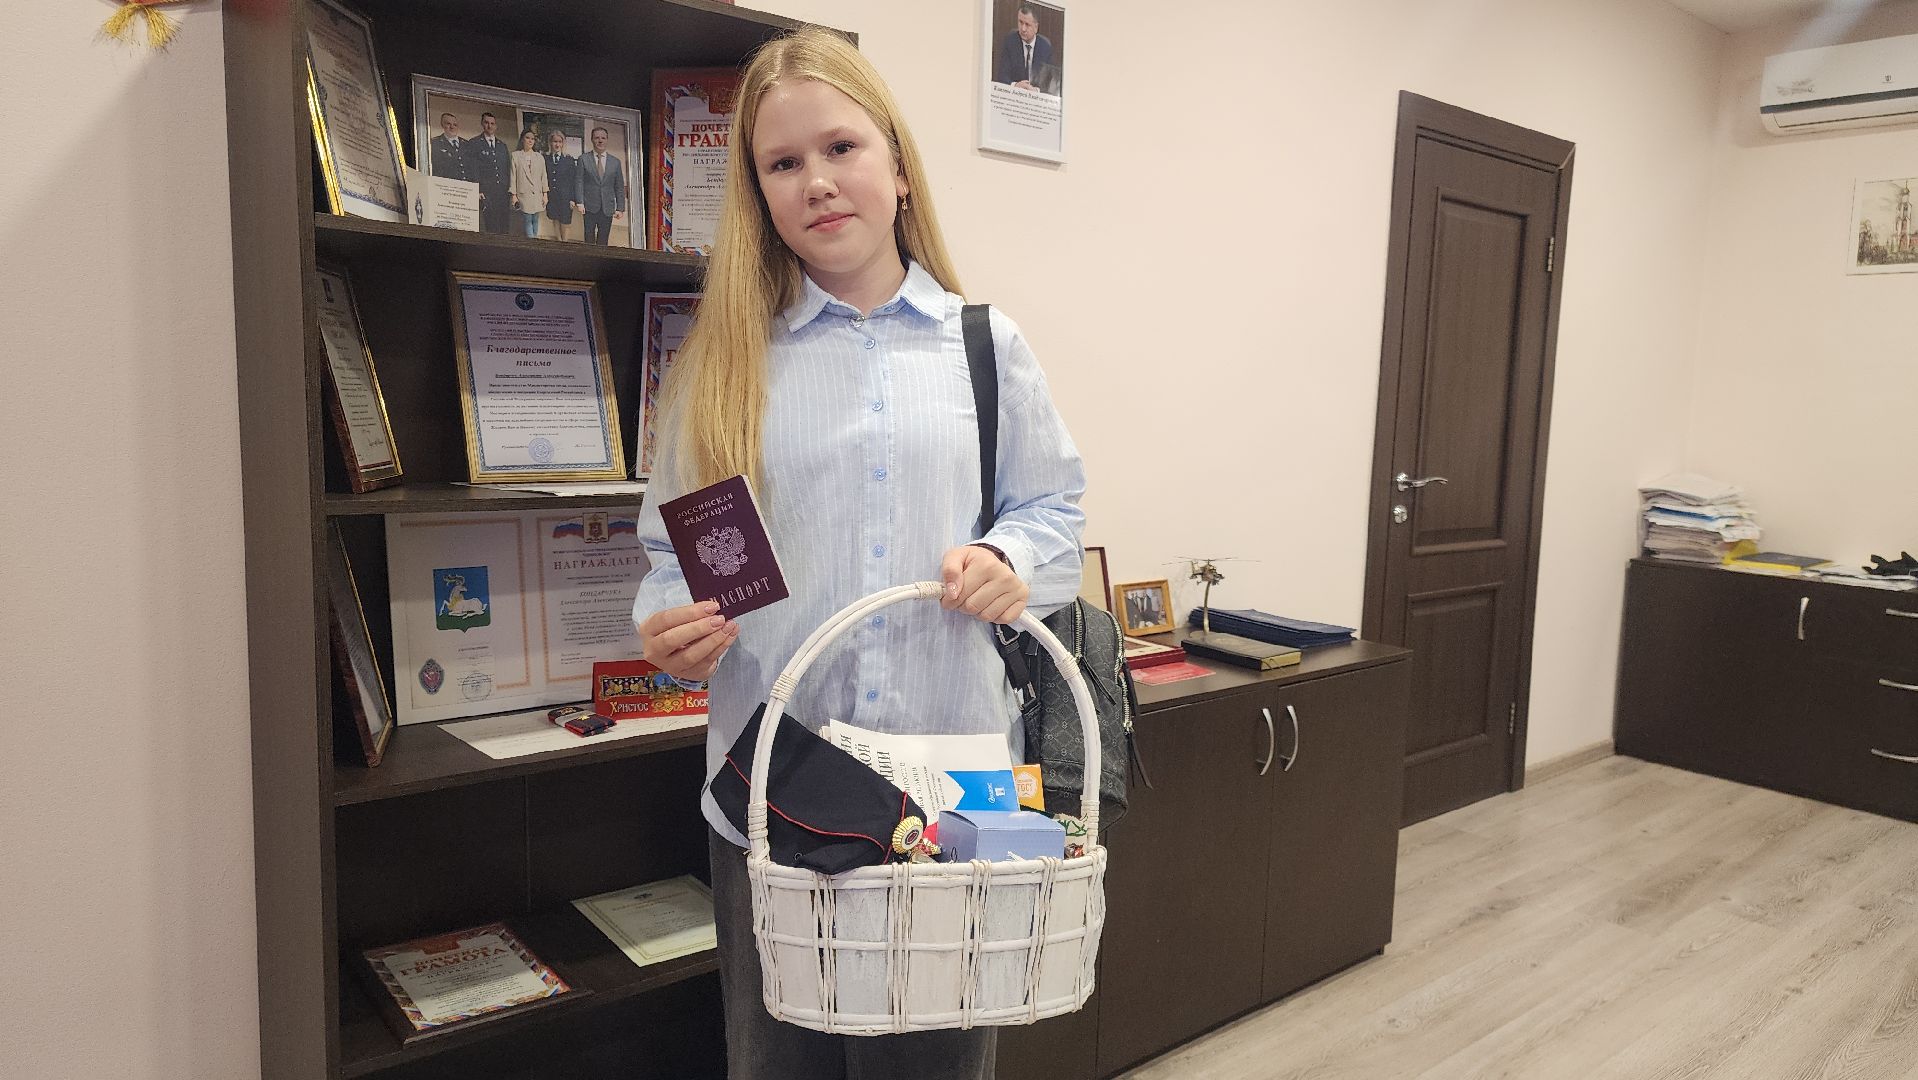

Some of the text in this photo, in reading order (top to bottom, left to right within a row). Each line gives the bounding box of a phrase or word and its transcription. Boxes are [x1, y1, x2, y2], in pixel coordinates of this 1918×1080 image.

[678, 133, 729, 147] ГРАМ
[486, 344, 577, 356] Благодарственное
[677, 492, 734, 519] РОССИЙСКАЯ
[683, 503, 734, 526] ФЕДЕРАЦИЯ
[553, 556, 640, 570] НАГРАЖДАЕТ
